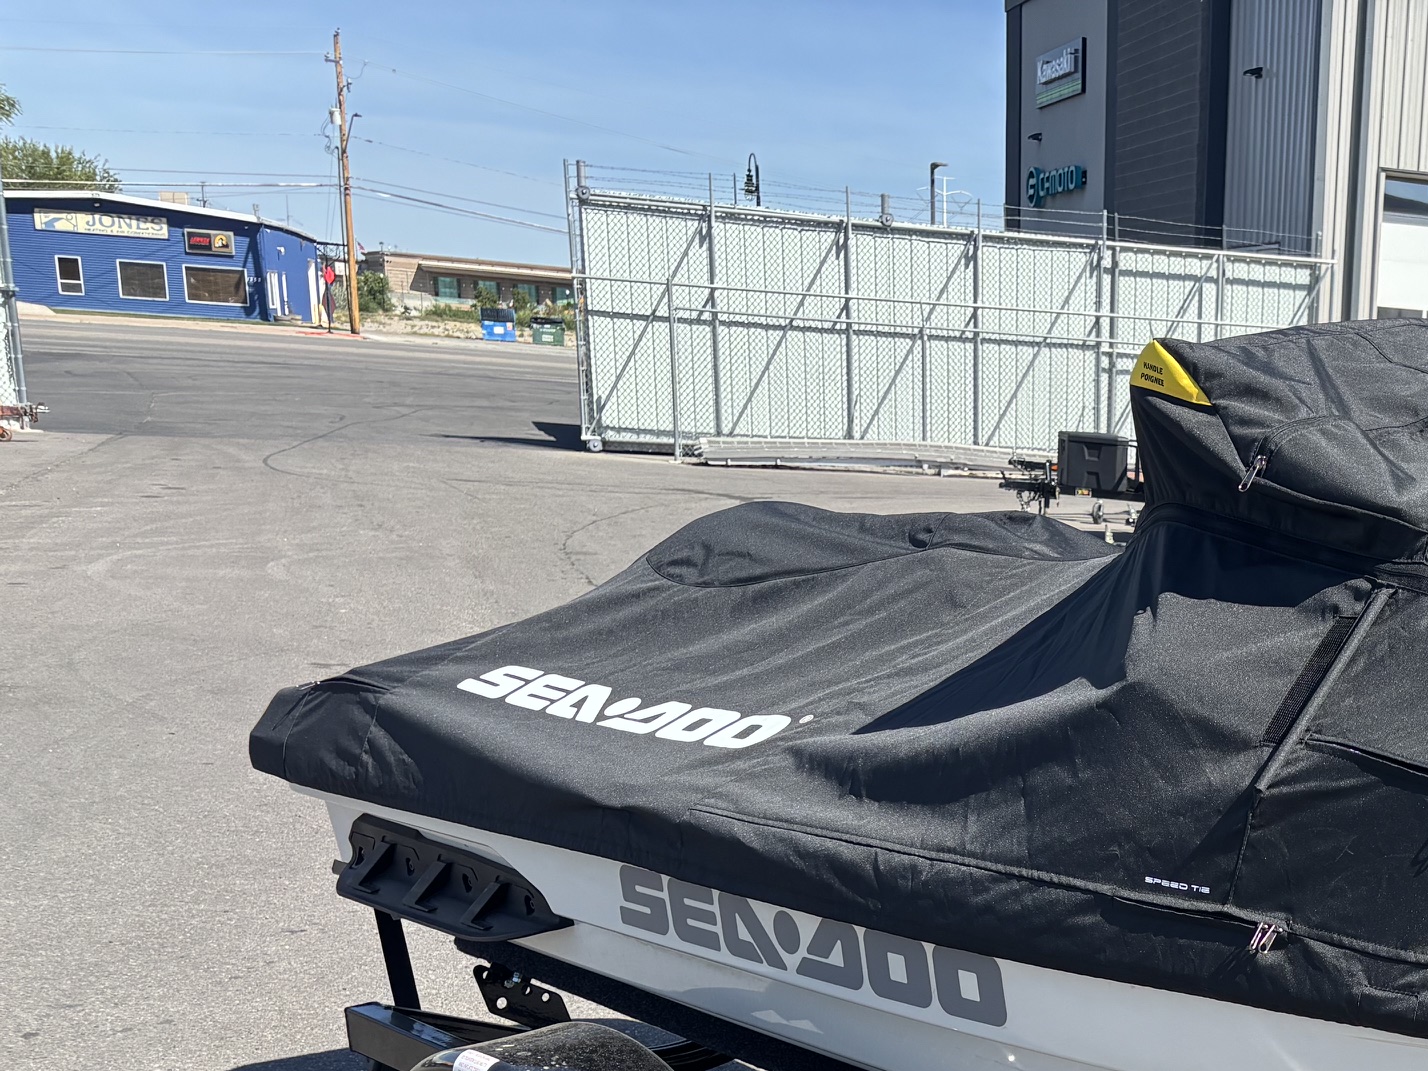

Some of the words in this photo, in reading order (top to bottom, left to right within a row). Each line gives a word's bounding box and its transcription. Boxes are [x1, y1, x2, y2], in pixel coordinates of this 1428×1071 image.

[1037, 48, 1074, 85] Kawasaki
[1038, 165, 1076, 197] CFMOTO
[85, 213, 164, 232] JONES
[1143, 361, 1164, 376] HANDLE
[1144, 876, 1188, 891] SPEED
[1191, 884, 1210, 894] TIE
